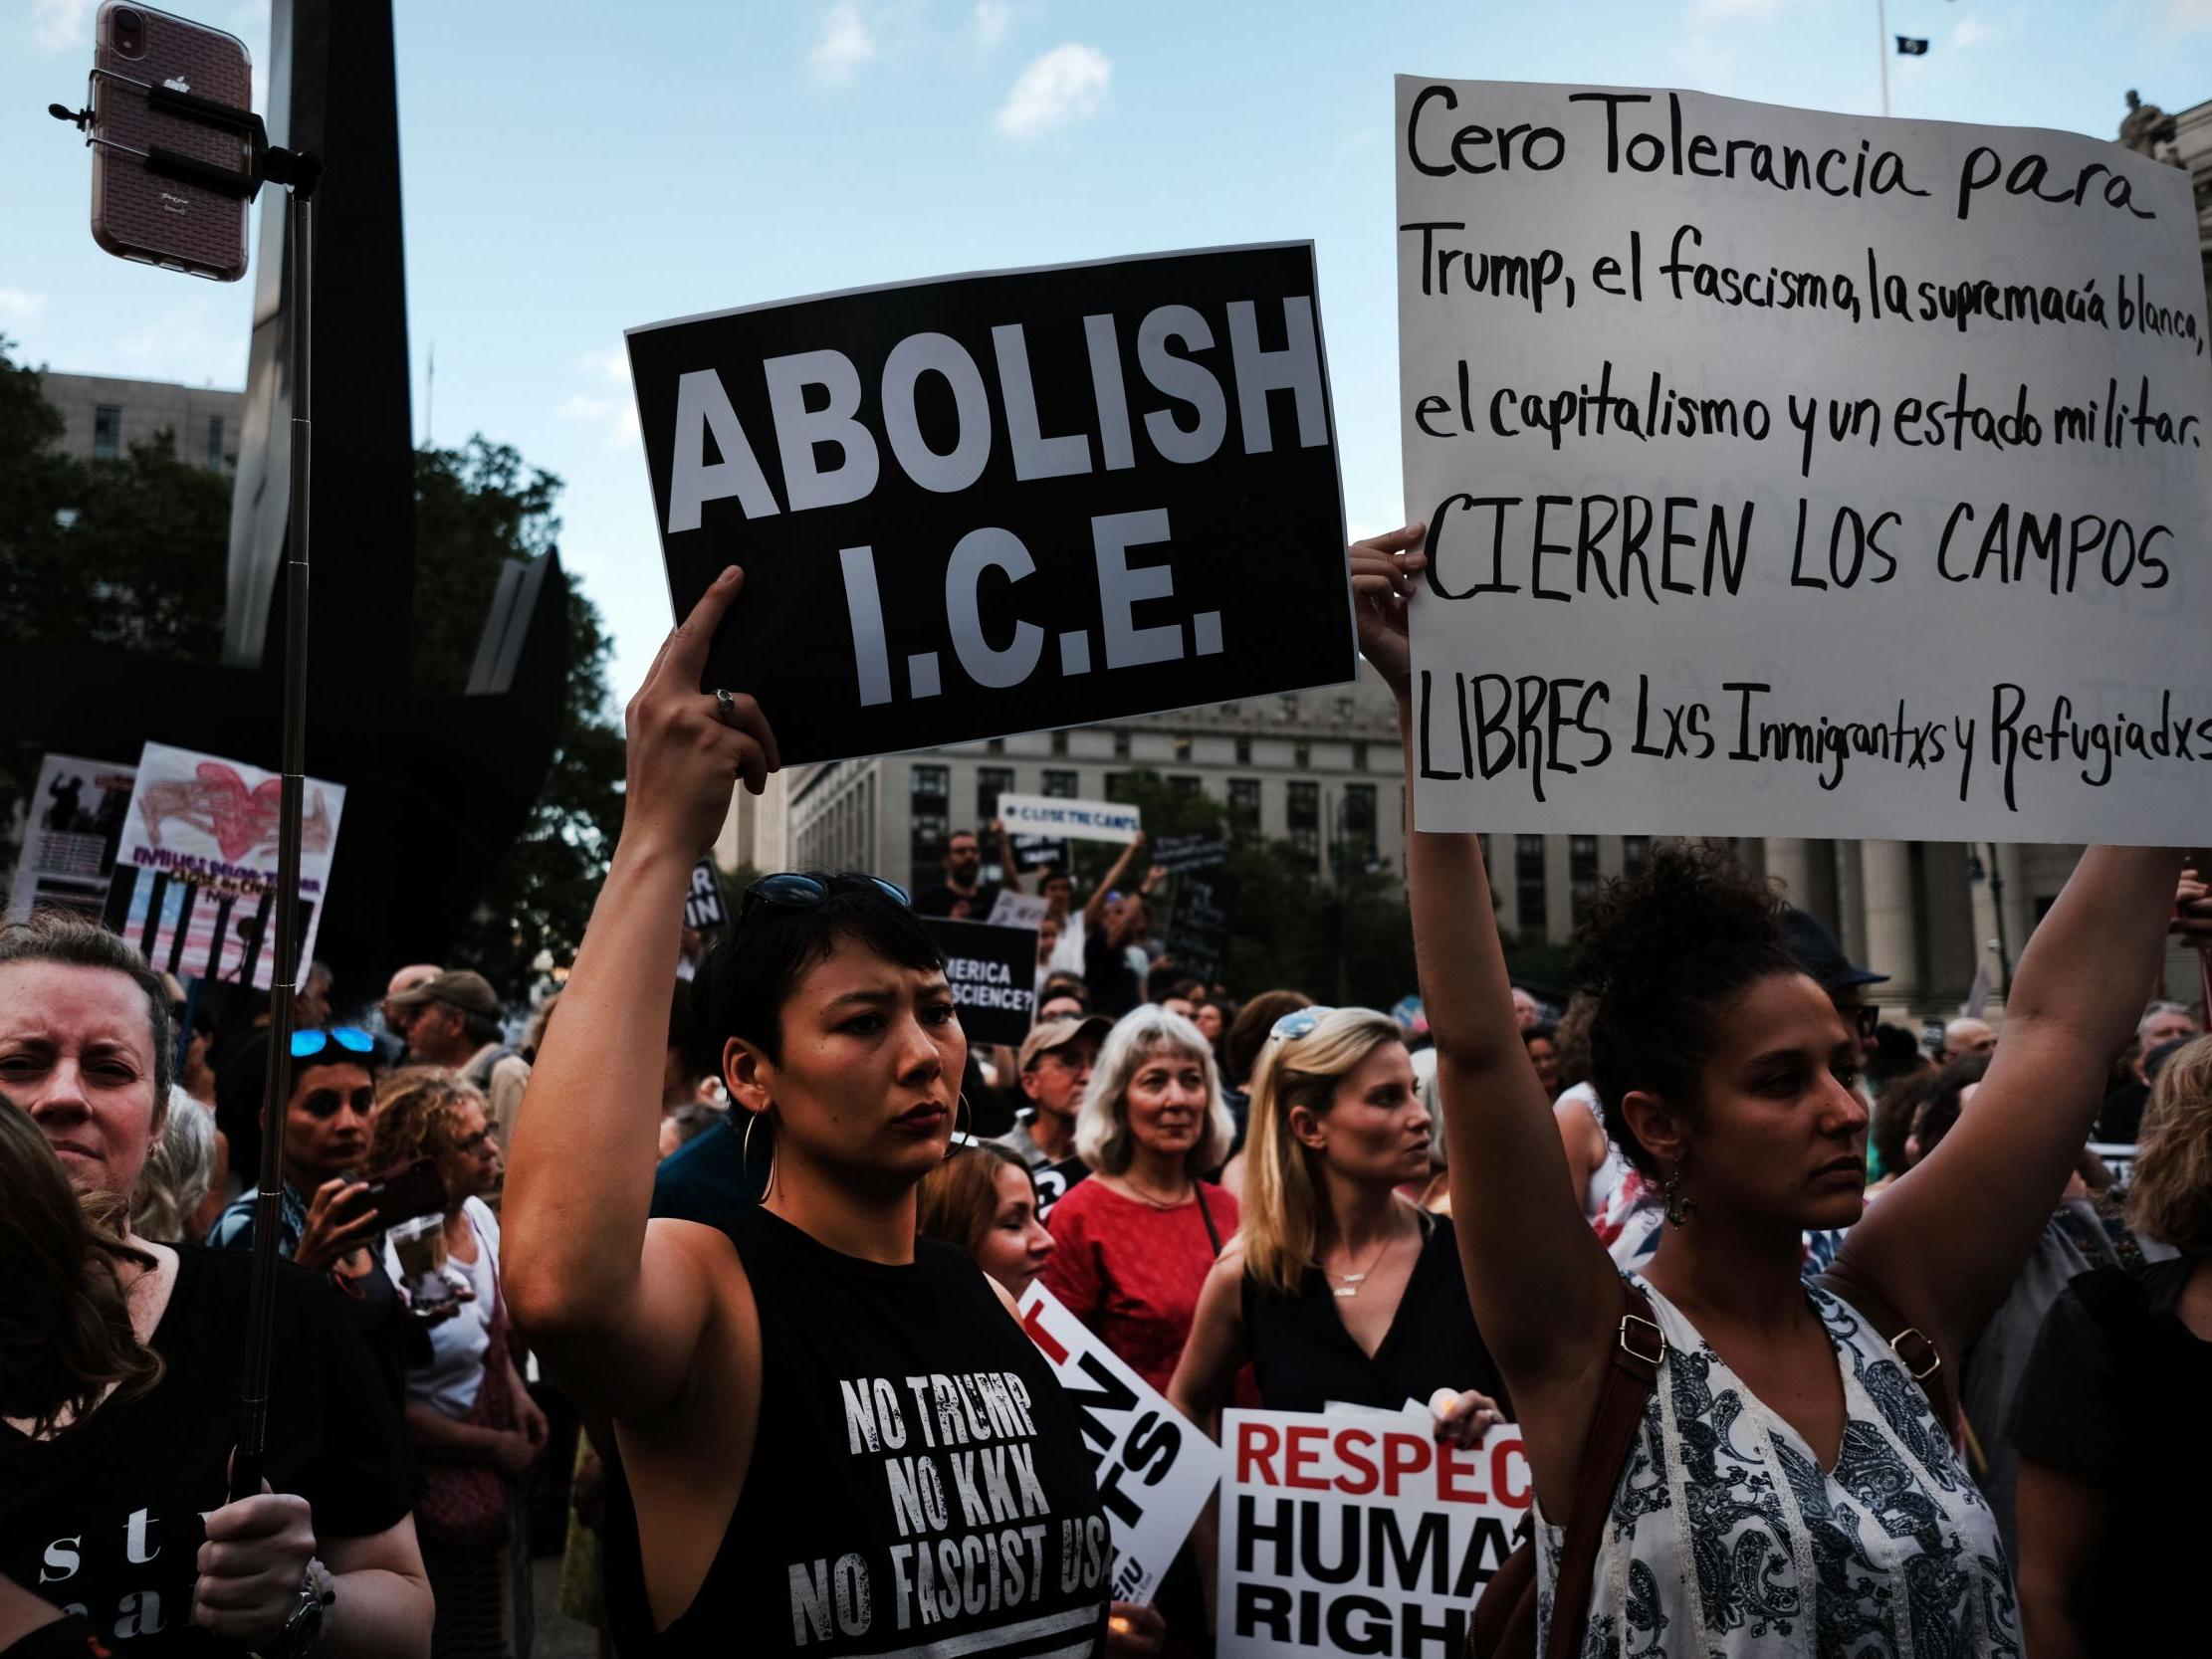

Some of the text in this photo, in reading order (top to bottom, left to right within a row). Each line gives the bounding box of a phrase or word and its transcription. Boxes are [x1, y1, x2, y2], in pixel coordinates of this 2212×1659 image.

[1408, 85, 2157, 220] Cero Tolerancia para
[1400, 222, 1576, 313] Trump,
[1593, 230, 1644, 302] el
[1868, 248, 1913, 322] la
[2118, 273, 2204, 356] blanca,
[667, 295, 1329, 534] ABOLISH
[1415, 359, 2201, 479] el capitalismo y un estado militar.
[1424, 493, 2175, 605] CIERREN LOS CAMPOS
[838, 508, 1225, 708] I.C.E.
[1420, 669, 2212, 812] LIBRES Lxs Inmigrantxs y Refugiadxs
[952, 982, 1034, 1012] SCIENCE?
[839, 1371, 1037, 1455] NO TRUMP
[1235, 1421, 1532, 1510] RESPEC
[884, 1442, 1051, 1537] NO KKK
[1235, 1494, 1513, 1598] HUMA
[787, 1553, 872, 1647] NO
[889, 1524, 1047, 1631] FASCIST
[1235, 1581, 1466, 1659] RIGH
